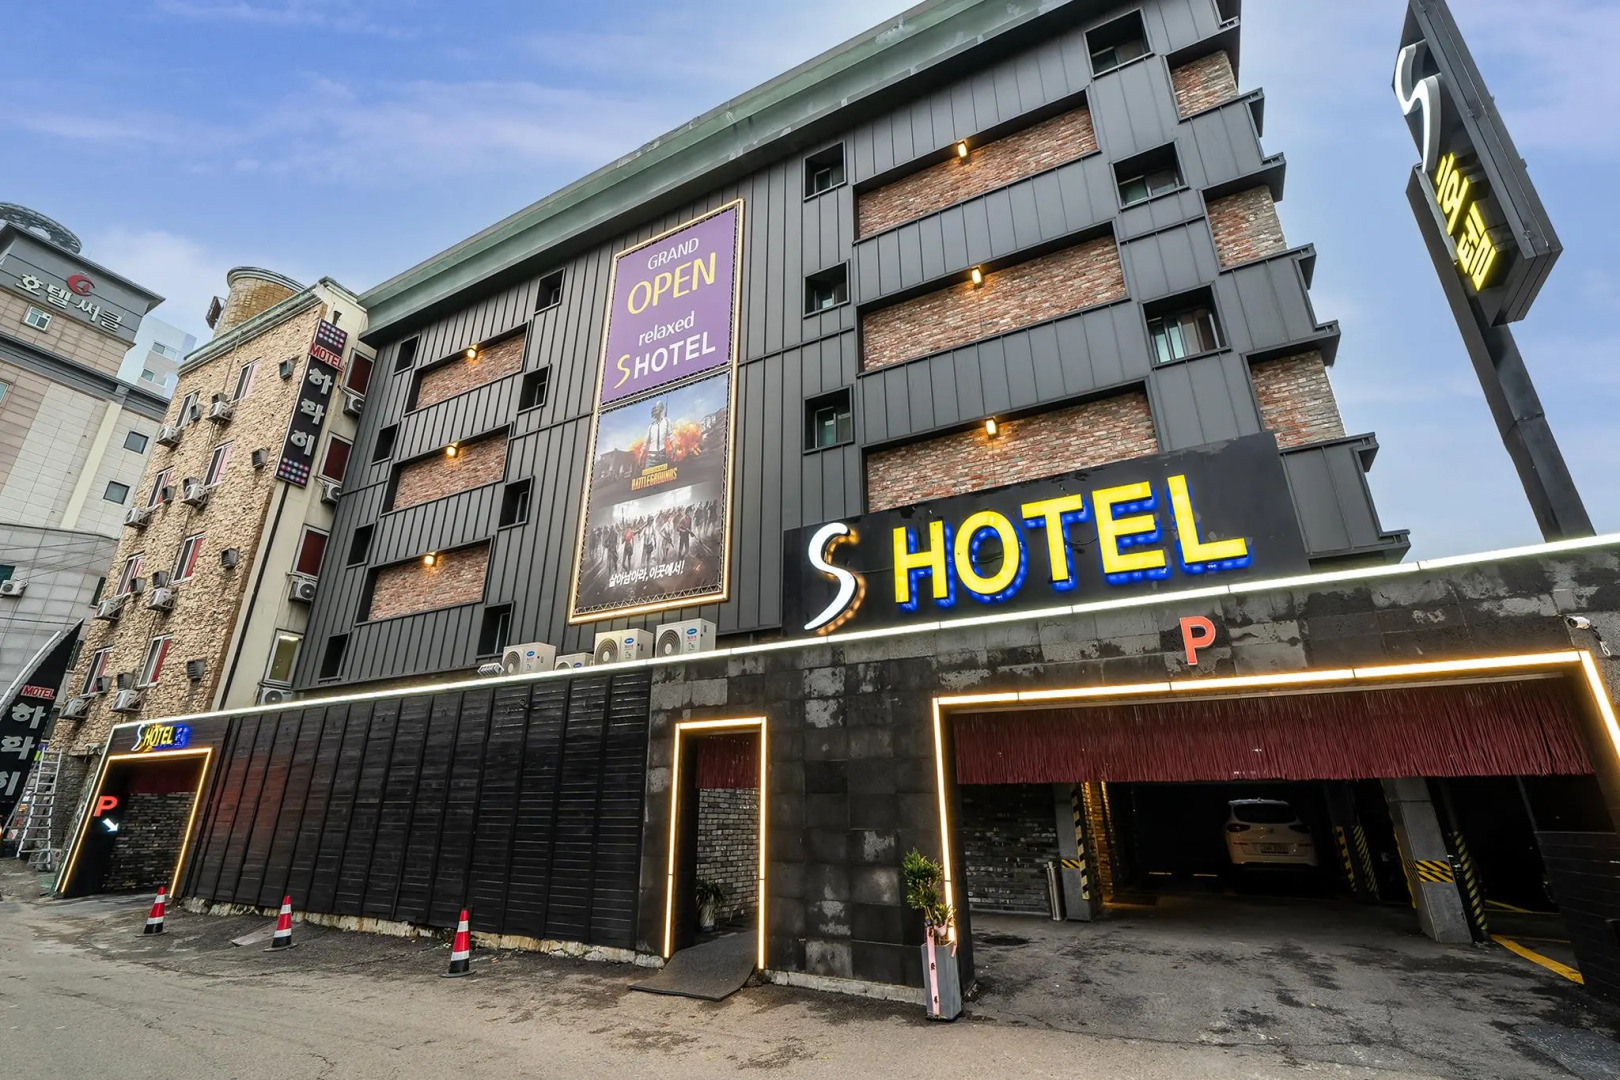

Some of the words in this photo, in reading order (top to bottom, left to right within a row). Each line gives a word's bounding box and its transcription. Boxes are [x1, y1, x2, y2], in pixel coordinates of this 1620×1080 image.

[1436, 152, 1497, 291] 호텔
[647, 237, 699, 270] GRAND
[627, 252, 716, 315] OPEN
[638, 310, 695, 347] relaxed
[309, 342, 344, 373] MOTEL
[892, 474, 1249, 606] HOTEL
[1178, 616, 1217, 667] P
[21, 685, 55, 699] MOTEL
[94, 795, 118, 816] P
